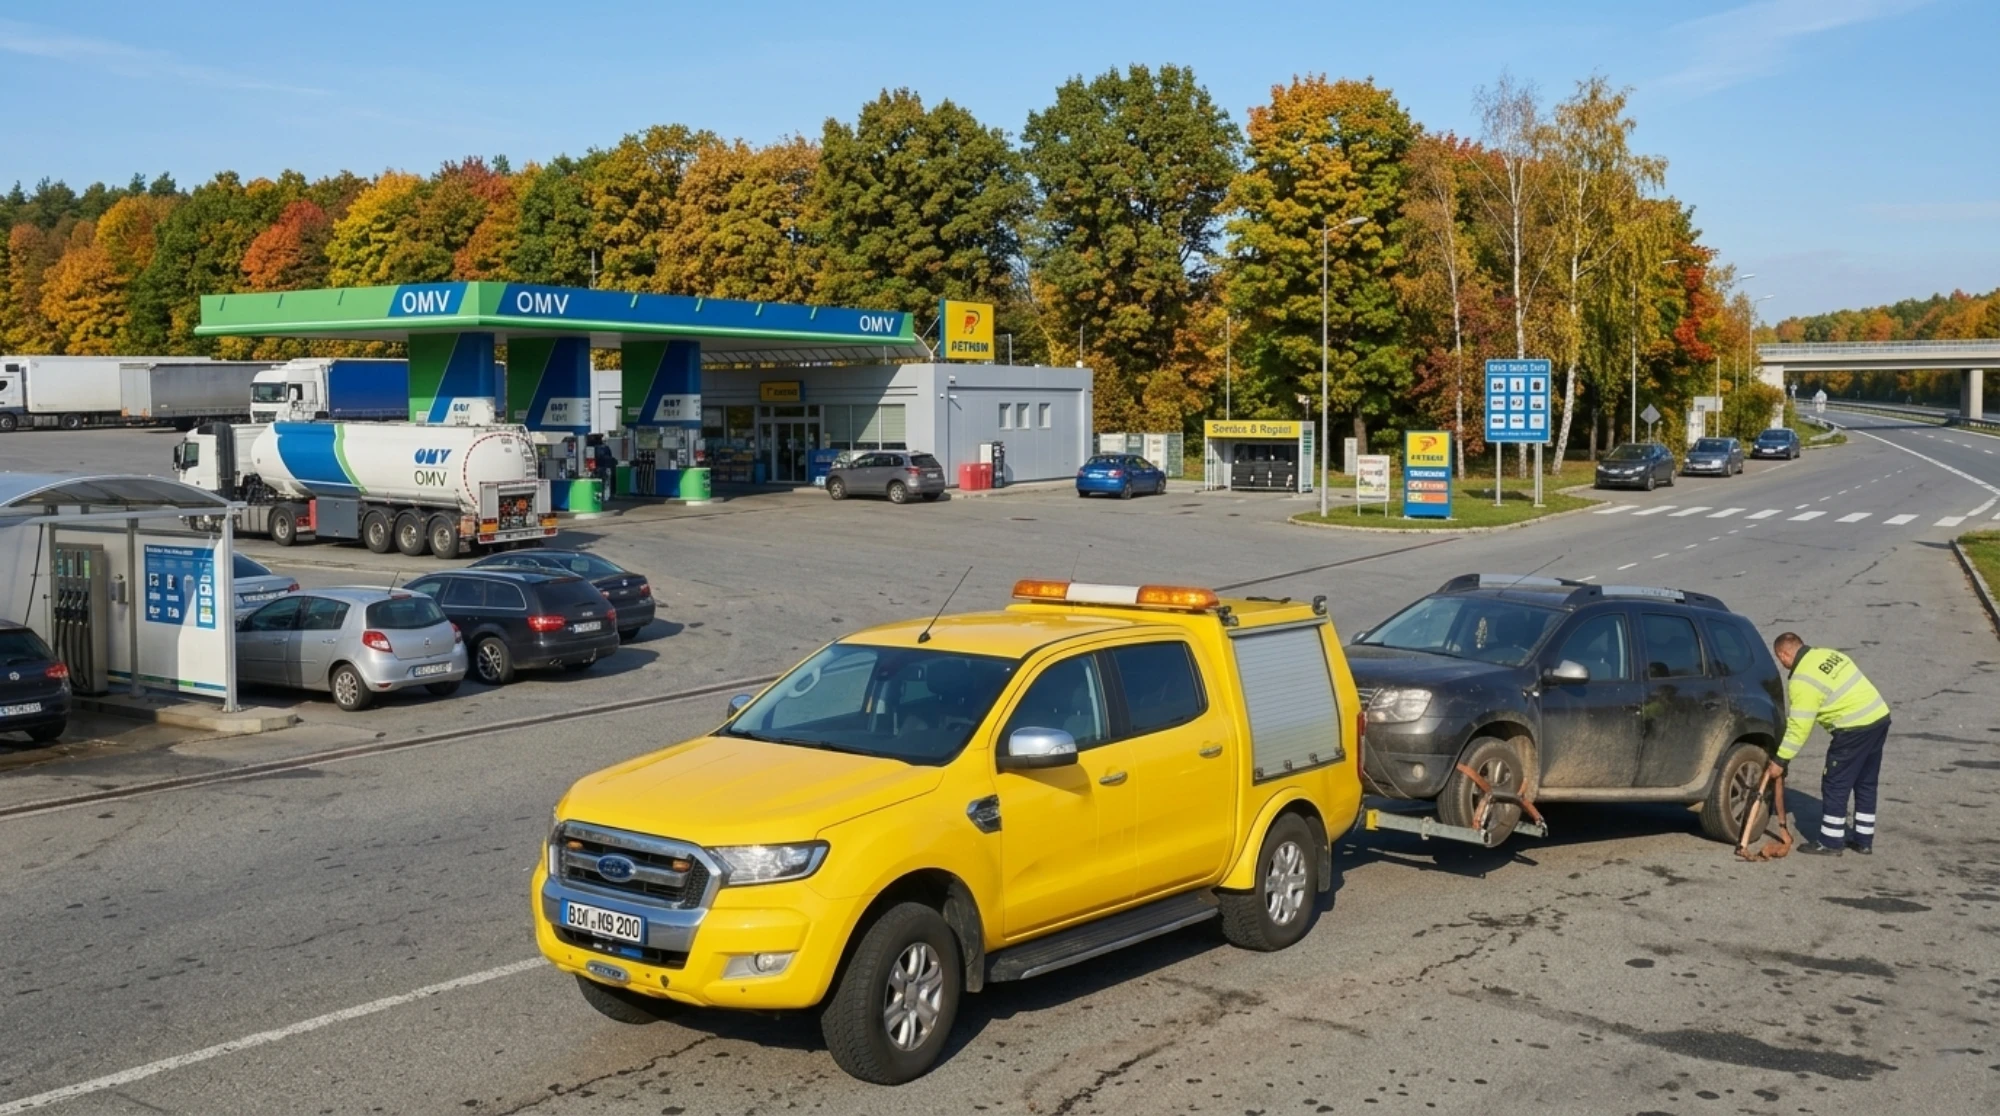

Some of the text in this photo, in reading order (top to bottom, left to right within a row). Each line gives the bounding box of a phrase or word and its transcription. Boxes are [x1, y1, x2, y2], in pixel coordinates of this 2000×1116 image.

[402, 290, 451, 313] OMV
[516, 291, 570, 315] OMV
[860, 315, 894, 332] OMV
[414, 470, 447, 487] OMV
[616, 916, 640, 938] 200
